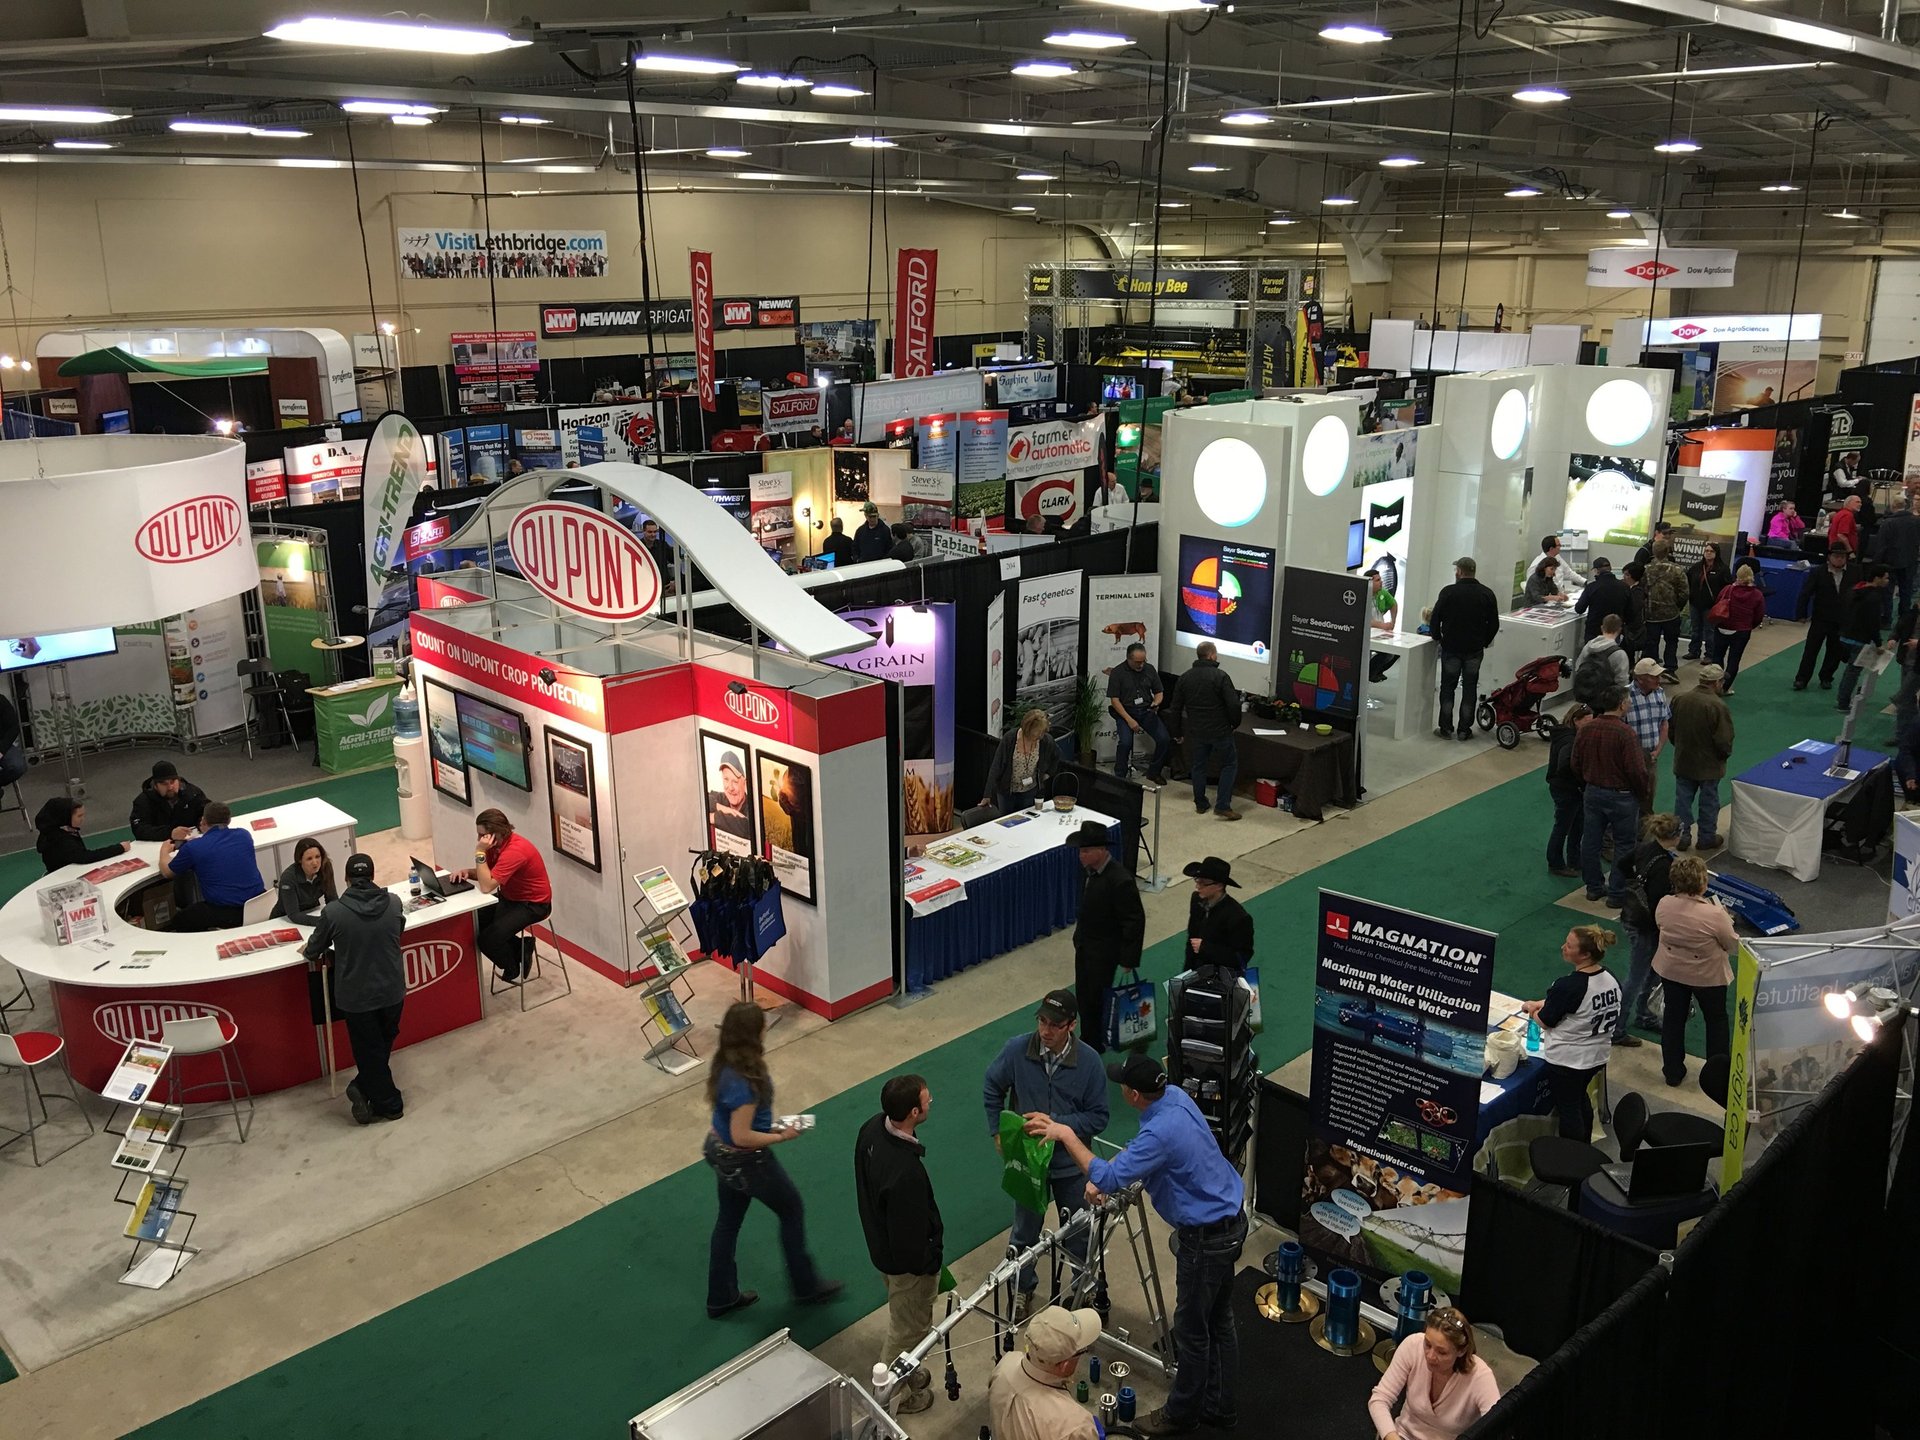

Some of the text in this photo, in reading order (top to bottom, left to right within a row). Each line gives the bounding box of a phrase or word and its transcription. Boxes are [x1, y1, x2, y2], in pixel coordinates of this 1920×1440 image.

[435, 232, 603, 255] VisitLethbridge.com
[1687, 266, 1702, 274] Dow
[1167, 278, 1188, 293] Bee
[1262, 277, 1285, 286] Harvest
[1263, 286, 1283, 295] Faster
[759, 299, 794, 310] NEWWAY
[580, 310, 641, 327] NEWWAY
[905, 256, 929, 378] SALFORD
[695, 260, 714, 403] SALFORD
[1678, 327, 1700, 336] DOW
[1727, 325, 1770, 333] AgroSciences
[332, 370, 353, 385] syngenta
[51, 402, 78, 414] syngenta
[281, 402, 307, 414] syngenta
[771, 396, 818, 416] SALFORD
[560, 411, 610, 431] Horizon
[971, 428, 996, 436] Focus
[1032, 428, 1073, 446] farmer
[1031, 437, 1092, 461] automatic
[1025, 458, 1063, 476] performance
[1064, 457, 1073, 467] by
[1778, 467, 1796, 481] you
[911, 475, 937, 485] Steve's
[1776, 483, 1783, 491] to
[369, 424, 414, 588] AGRI-TREND
[1041, 494, 1071, 509] CLARK
[1686, 501, 1718, 512] InVigor
[933, 534, 978, 555] Fabian
[1674, 537, 1705, 546] STRAIGHT
[1023, 594, 1040, 604] Fast
[1096, 592, 1132, 601] TERMINAL
[1292, 614, 1309, 625] Bayer
[857, 653, 925, 671] GRAIN
[416, 631, 597, 715] COUNT ON DUPONT CROP PROTECTION
[885, 670, 915, 679] WORLD
[1095, 730, 1111, 738] Fast
[339, 744, 350, 752] THE
[351, 741, 371, 749] POWER
[68, 905, 96, 922] WIN
[1352, 920, 1482, 966] MAGNATION
[1351, 933, 1479, 974] WATER TECHNOLOGIES MADE IN USA
[1333, 941, 1472, 987] The Leader in Chemical-free Water Treatment
[1322, 957, 1482, 1013] Maximum Water Utilization
[1339, 977, 1365, 993] with
[1367, 983, 1416, 1007] Rainlike
[1591, 987, 1619, 1012] CIGI
[1124, 1010, 1140, 1026] Ag
[1591, 1010, 1619, 1037] 72
[1132, 1020, 1149, 1035] Life
[1729, 1052, 1745, 1150] cigi.ca
[1345, 1138, 1426, 1176] MagnationWater.com
[1315, 1209, 1354, 1229] with less water
[1319, 1217, 1329, 1226] and
[1340, 1212, 1354, 1222] yield
